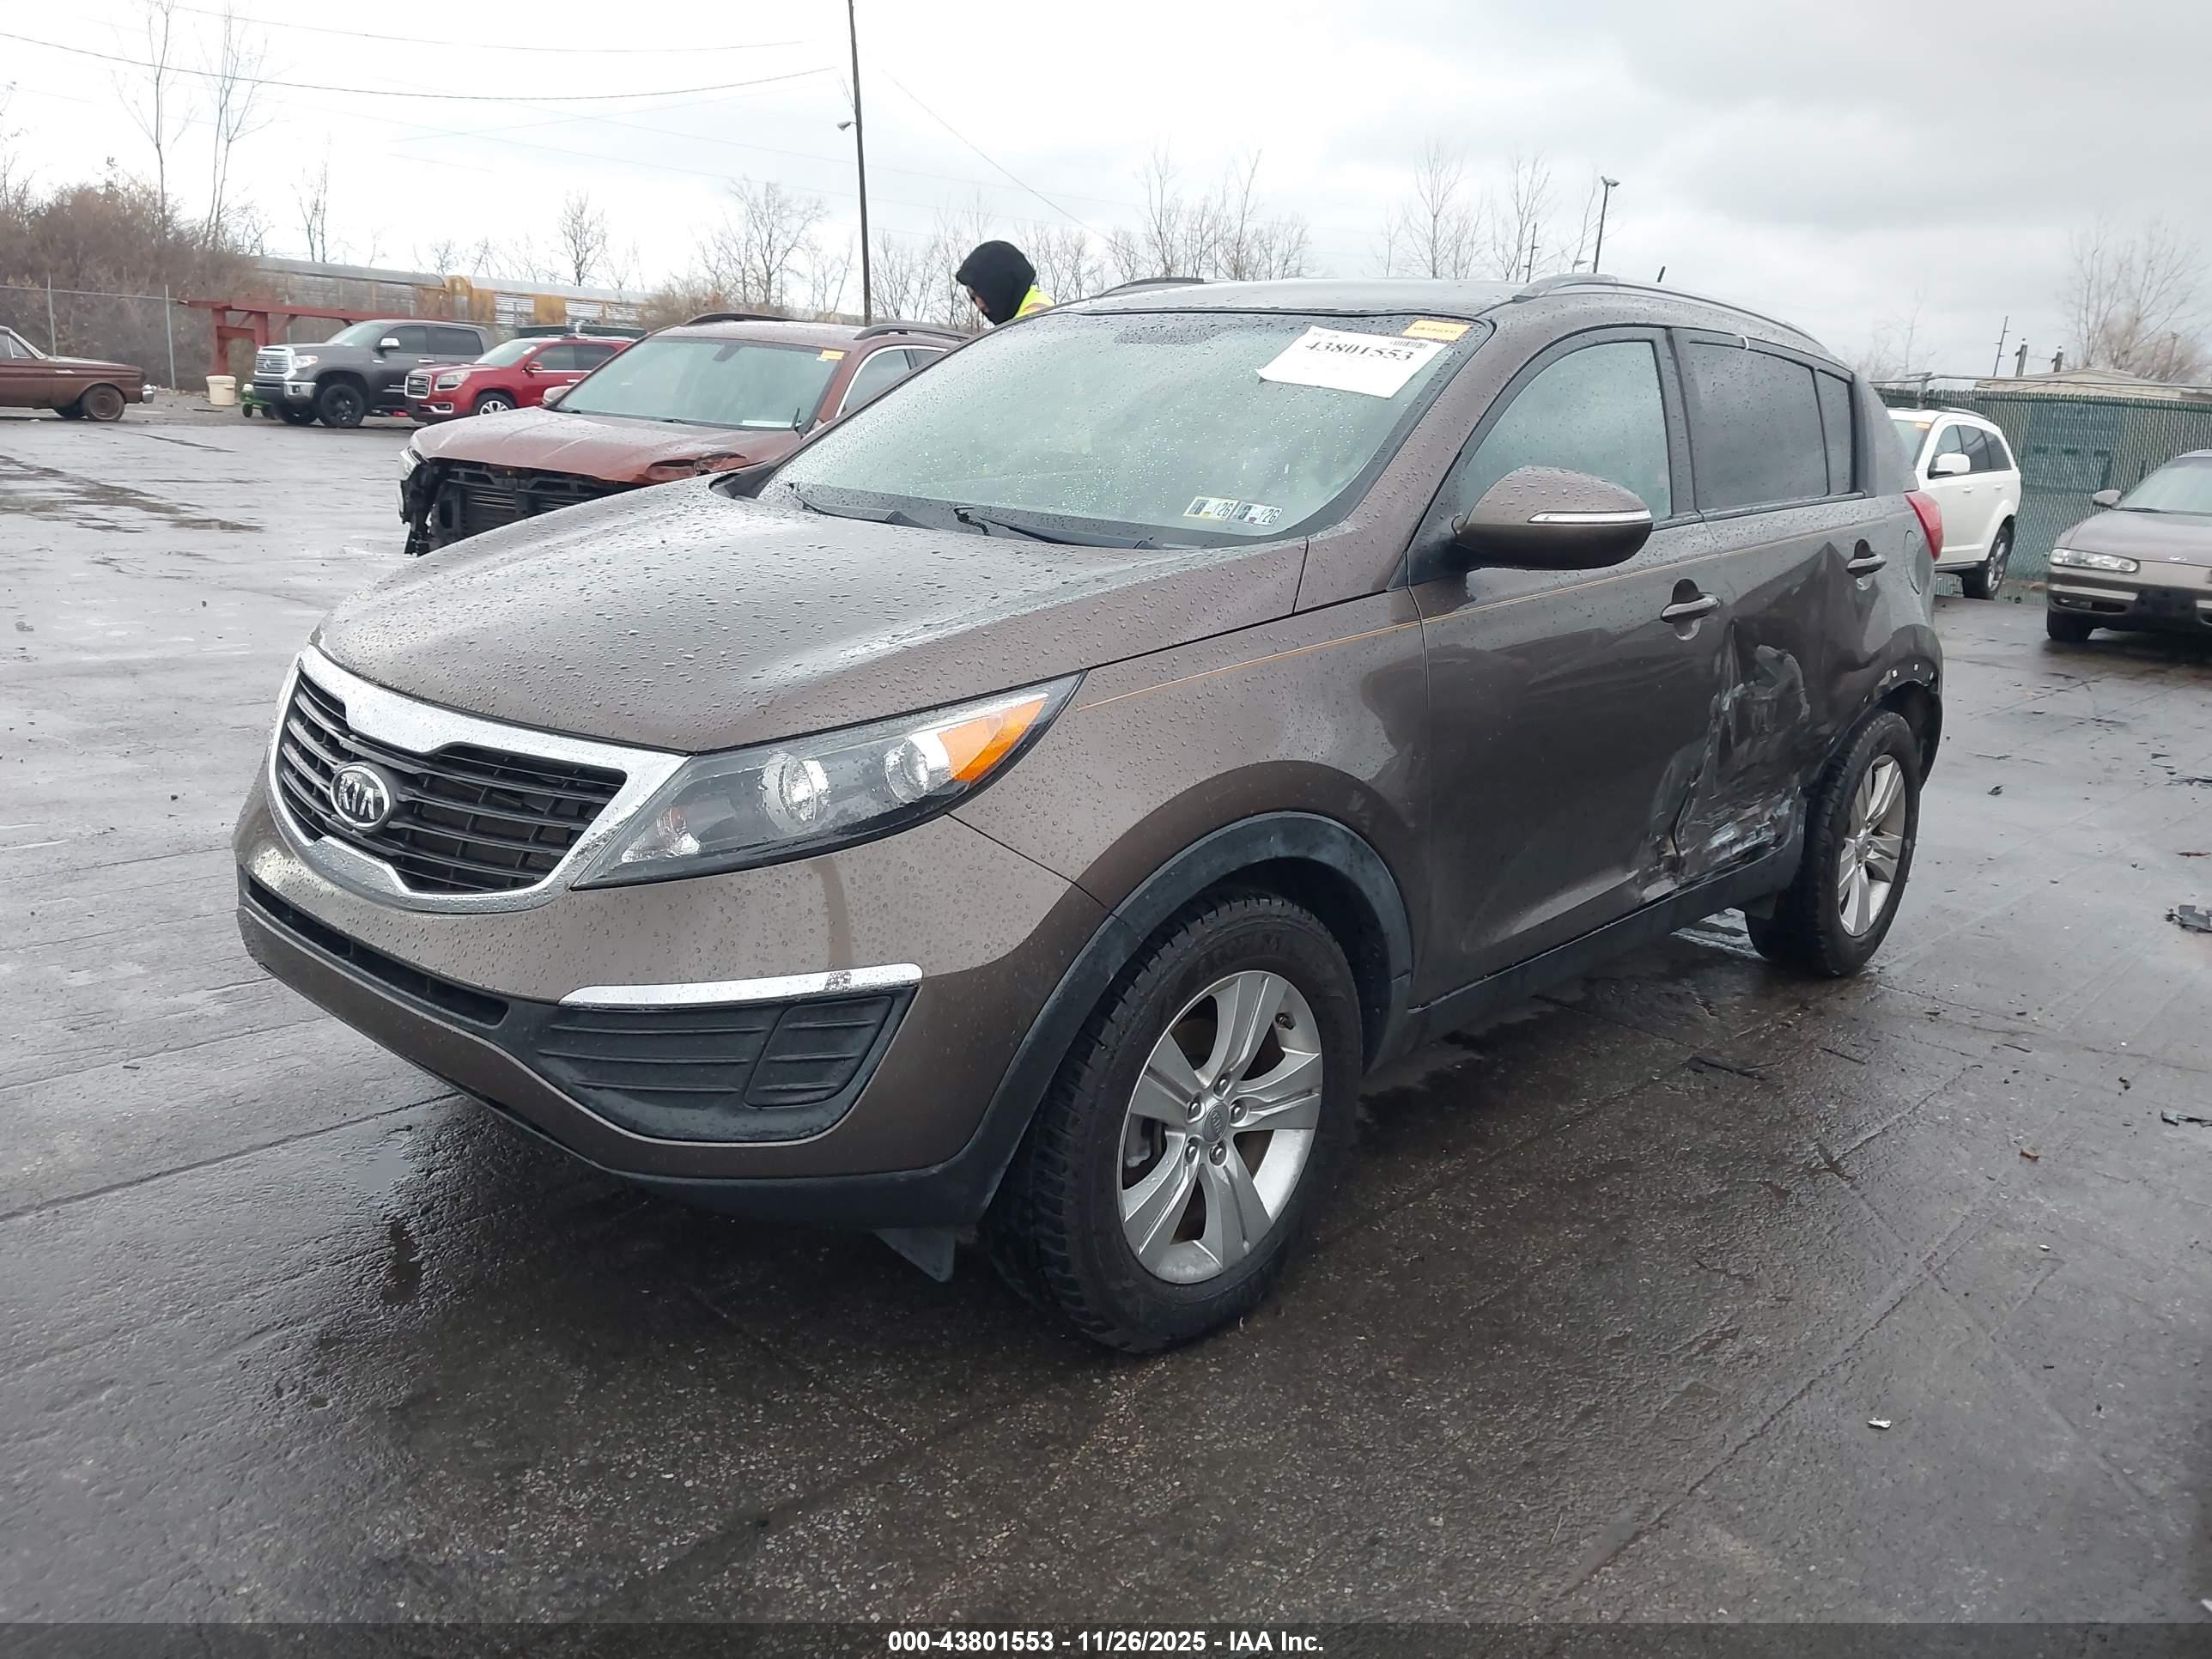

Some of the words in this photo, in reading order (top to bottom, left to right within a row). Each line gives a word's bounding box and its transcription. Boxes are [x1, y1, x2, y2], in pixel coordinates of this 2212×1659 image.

[1304, 340, 1416, 362] 43801553
[1261, 508, 1280, 523] 26
[338, 772, 375, 820] KIA
